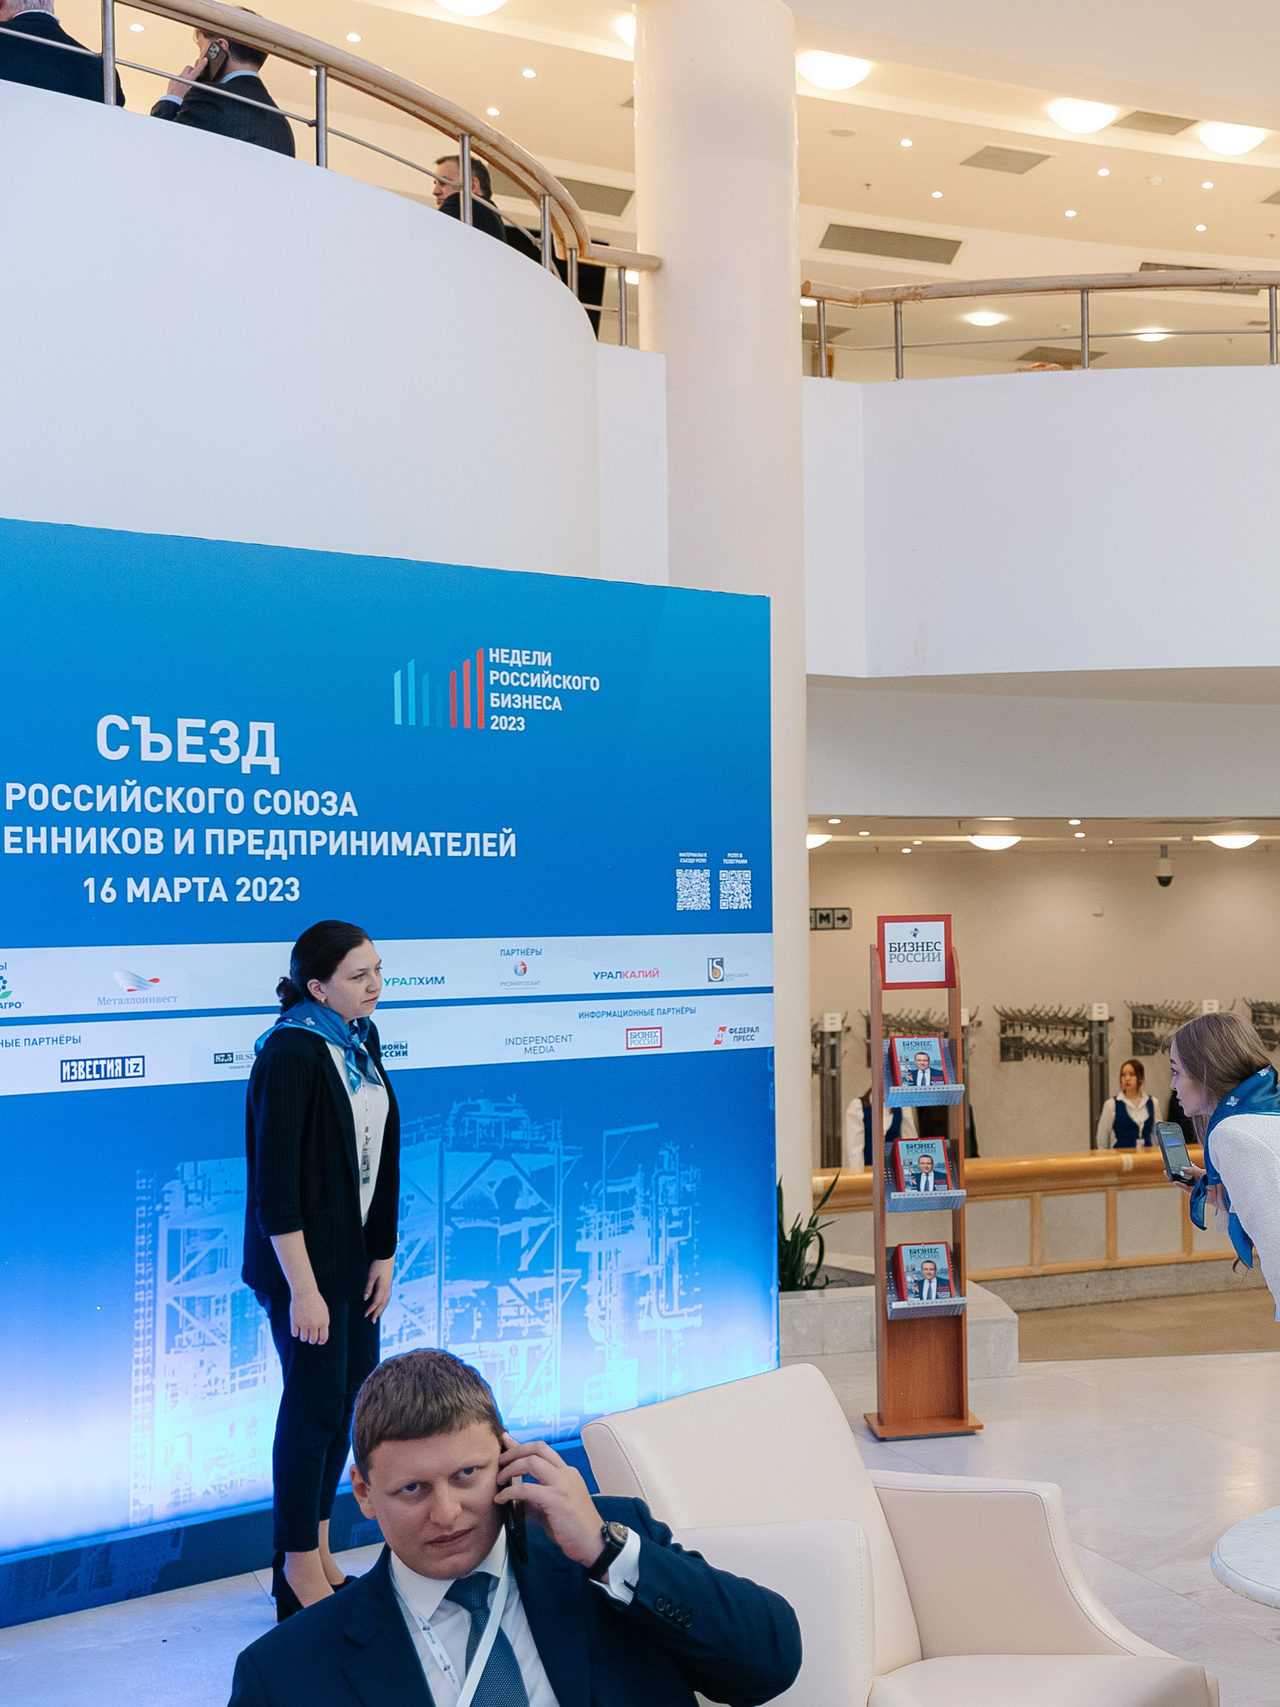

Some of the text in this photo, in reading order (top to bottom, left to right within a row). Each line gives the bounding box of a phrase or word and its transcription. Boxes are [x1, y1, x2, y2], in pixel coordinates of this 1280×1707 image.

[489, 648, 552, 667] НЕДЕЛИ
[489, 670, 600, 692] РОССИЙСКОГО
[490, 692, 563, 711] БИЗНЕСА
[490, 715, 526, 731] 2023
[96, 714, 280, 775] СЪЕЗД
[6, 779, 359, 817] РОССИЙСКОГО СОЮЗА
[4, 826, 517, 861] ЕННИКОВ И ПРЕДПРИНИМАТЕЛЕЙ
[83, 876, 301, 903] 16 МАРТА 2023
[500, 948, 543, 956] ПАРТНЁРЫ
[888, 941, 942, 953] БИЗНЕС
[888, 952, 942, 963] РОССИИ
[593, 968, 660, 980] УРАЛКАЛИЙ
[383, 976, 446, 986] УРАЛХИМ
[97, 996, 179, 1006] Металлоинвест
[578, 1006, 697, 1019] ИНФОРМАЦИОННЫЕ ПАРТНЁРЫ
[630, 1031, 659, 1039] БИЗНЕС
[728, 1026, 760, 1034] ФЕДЕРАЛ
[24, 1034, 82, 1047] ПАРТНЁРЫ
[504, 1034, 574, 1046] INDEPENDENT
[630, 1038, 659, 1046] РОССИИ
[733, 1034, 756, 1042] ПРЕСС
[524, 1045, 556, 1055] MEDIA
[62, 1058, 123, 1081] ИЗВЕСТИЯ
